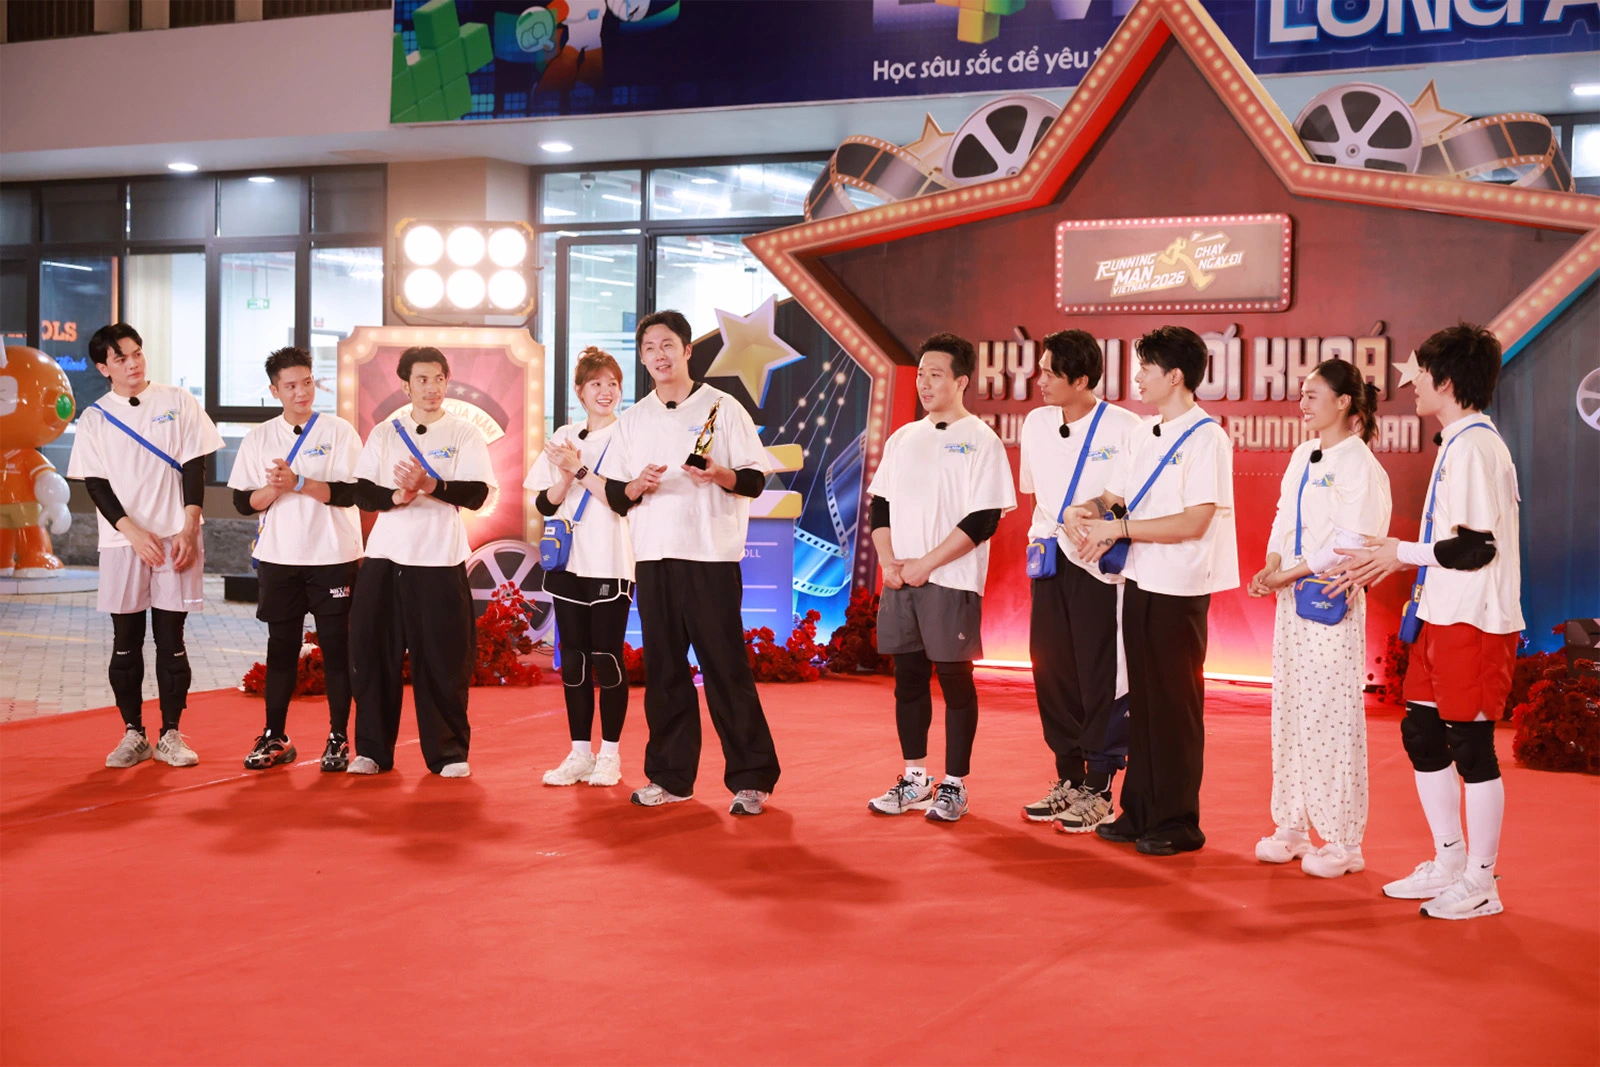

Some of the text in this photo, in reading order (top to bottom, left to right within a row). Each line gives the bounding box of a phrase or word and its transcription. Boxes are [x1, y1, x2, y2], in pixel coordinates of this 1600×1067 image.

[873, 59, 916, 84] Học
[920, 55, 960, 78] sâu
[965, 49, 1003, 74] sắc
[1007, 45, 1040, 72] để
[1044, 47, 1089, 74] yêu
[1096, 252, 1158, 279] RUNNING
[1198, 254, 1230, 270] NGAY
[1112, 271, 1187, 295] VIETNAM 2026
[1114, 265, 1155, 286] MAN
[978, 326, 1036, 400] KỲ
